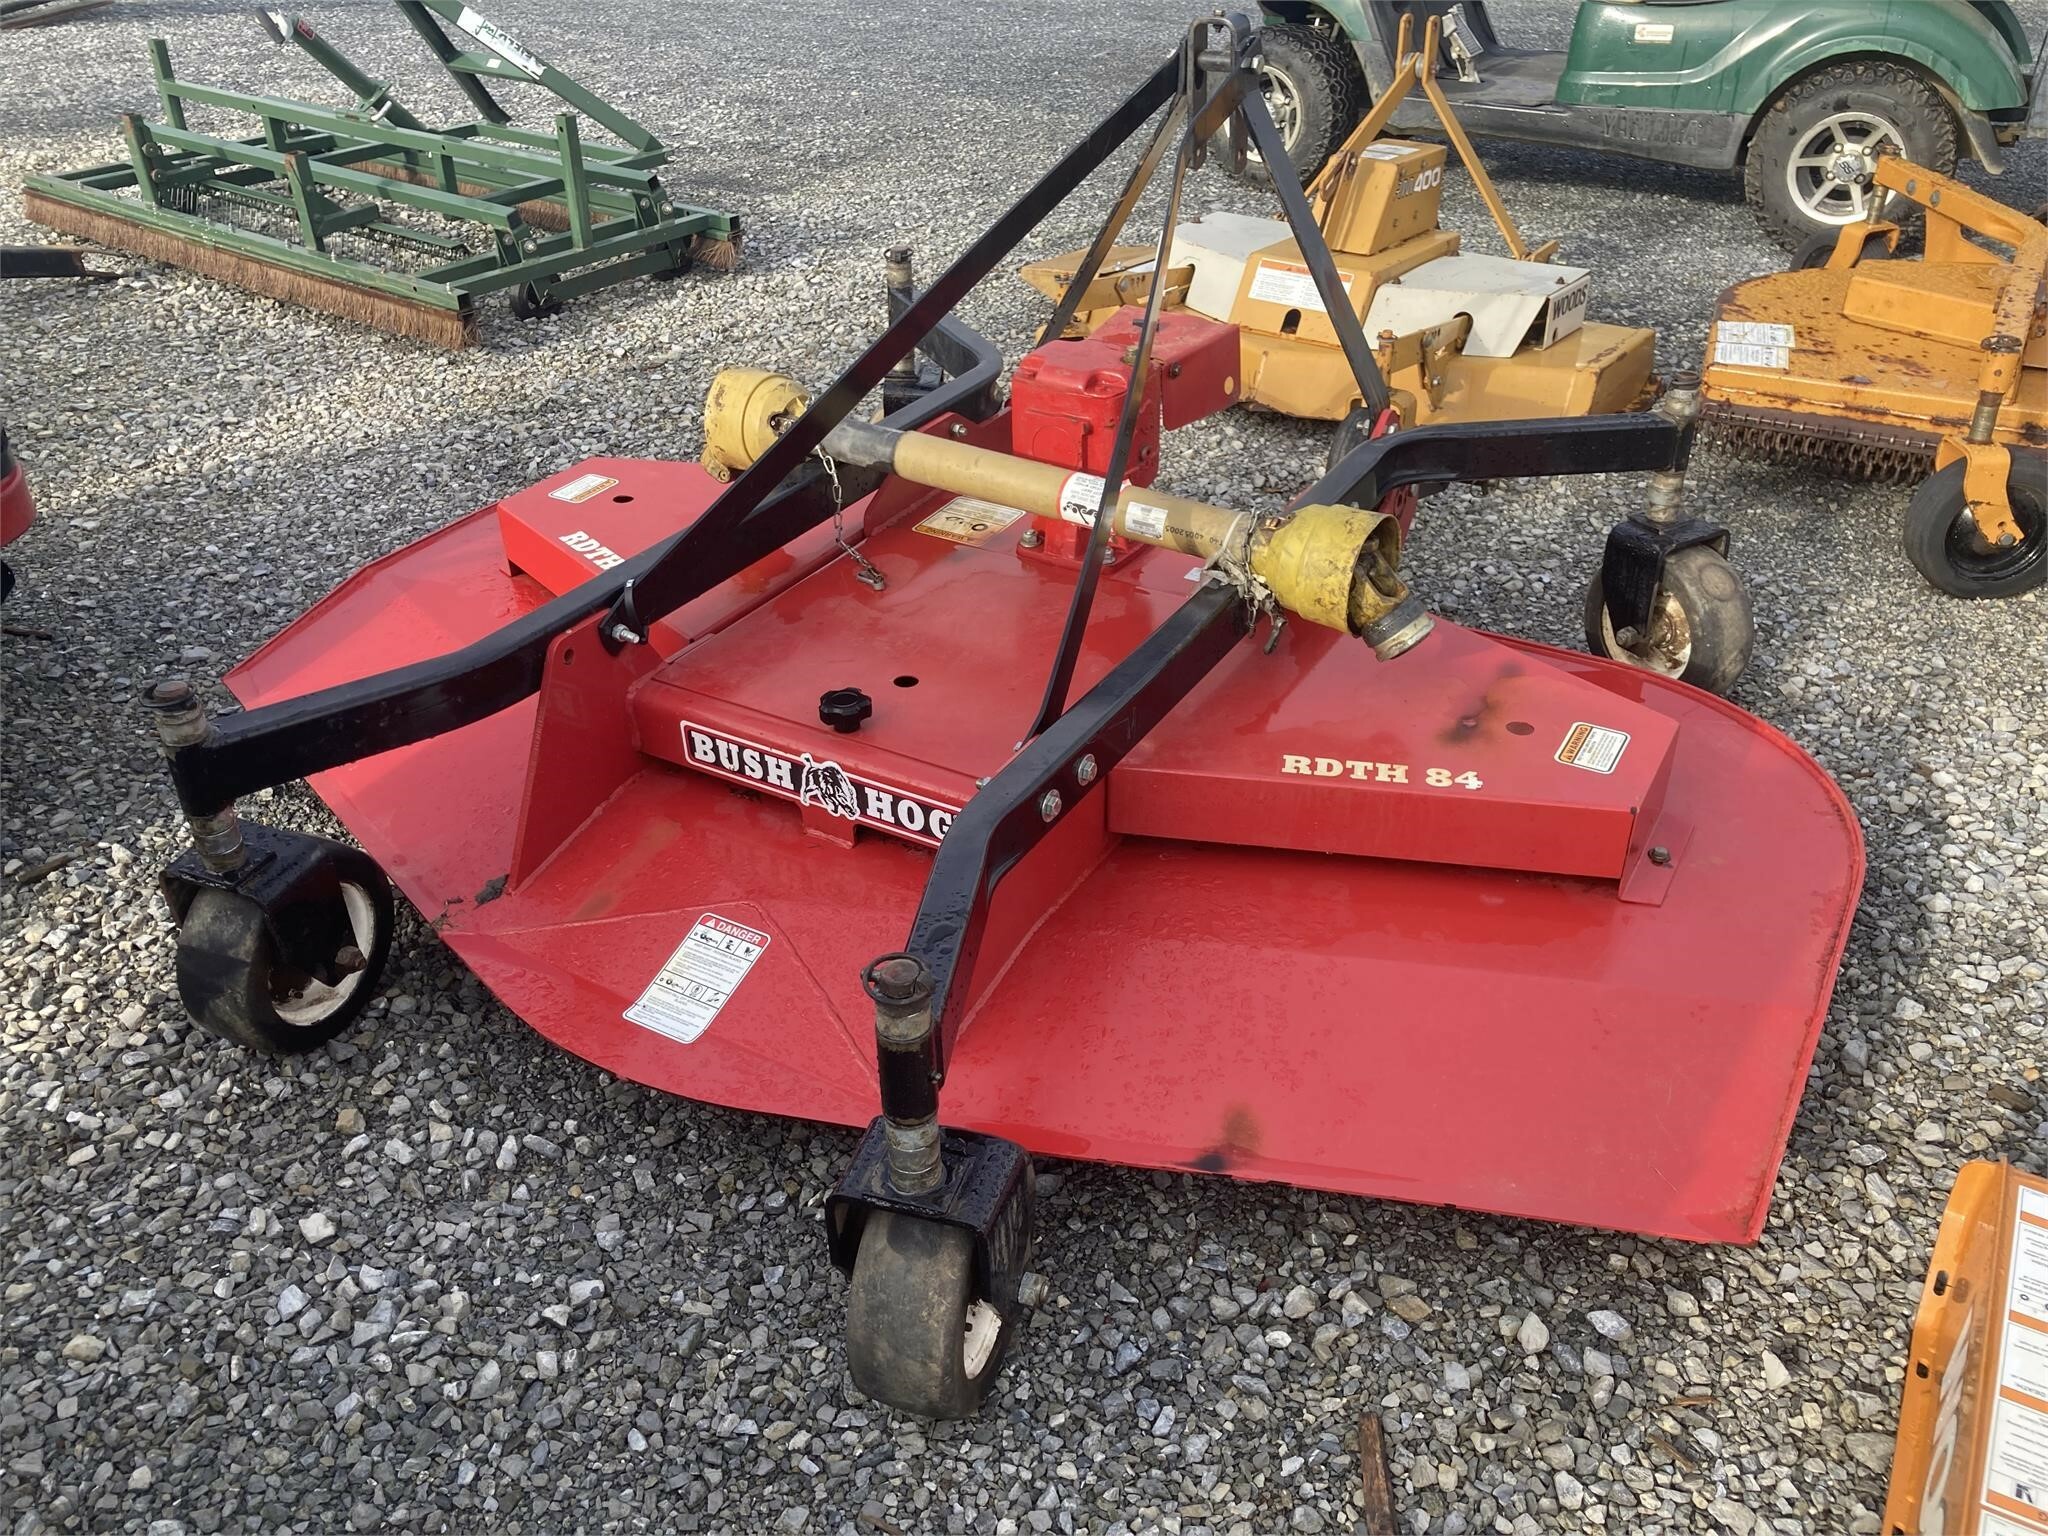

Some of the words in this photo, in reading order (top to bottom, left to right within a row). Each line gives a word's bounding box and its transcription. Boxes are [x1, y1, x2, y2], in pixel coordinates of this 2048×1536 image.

[1553, 284, 1588, 320] WOODS
[558, 530, 625, 570] RDTH
[1567, 727, 1588, 754] WARNING
[691, 731, 794, 790] BUSH
[865, 787, 957, 839] HOG
[1281, 754, 1409, 784] RDTH
[1425, 768, 1484, 790] 84
[716, 922, 763, 945] DANGER
